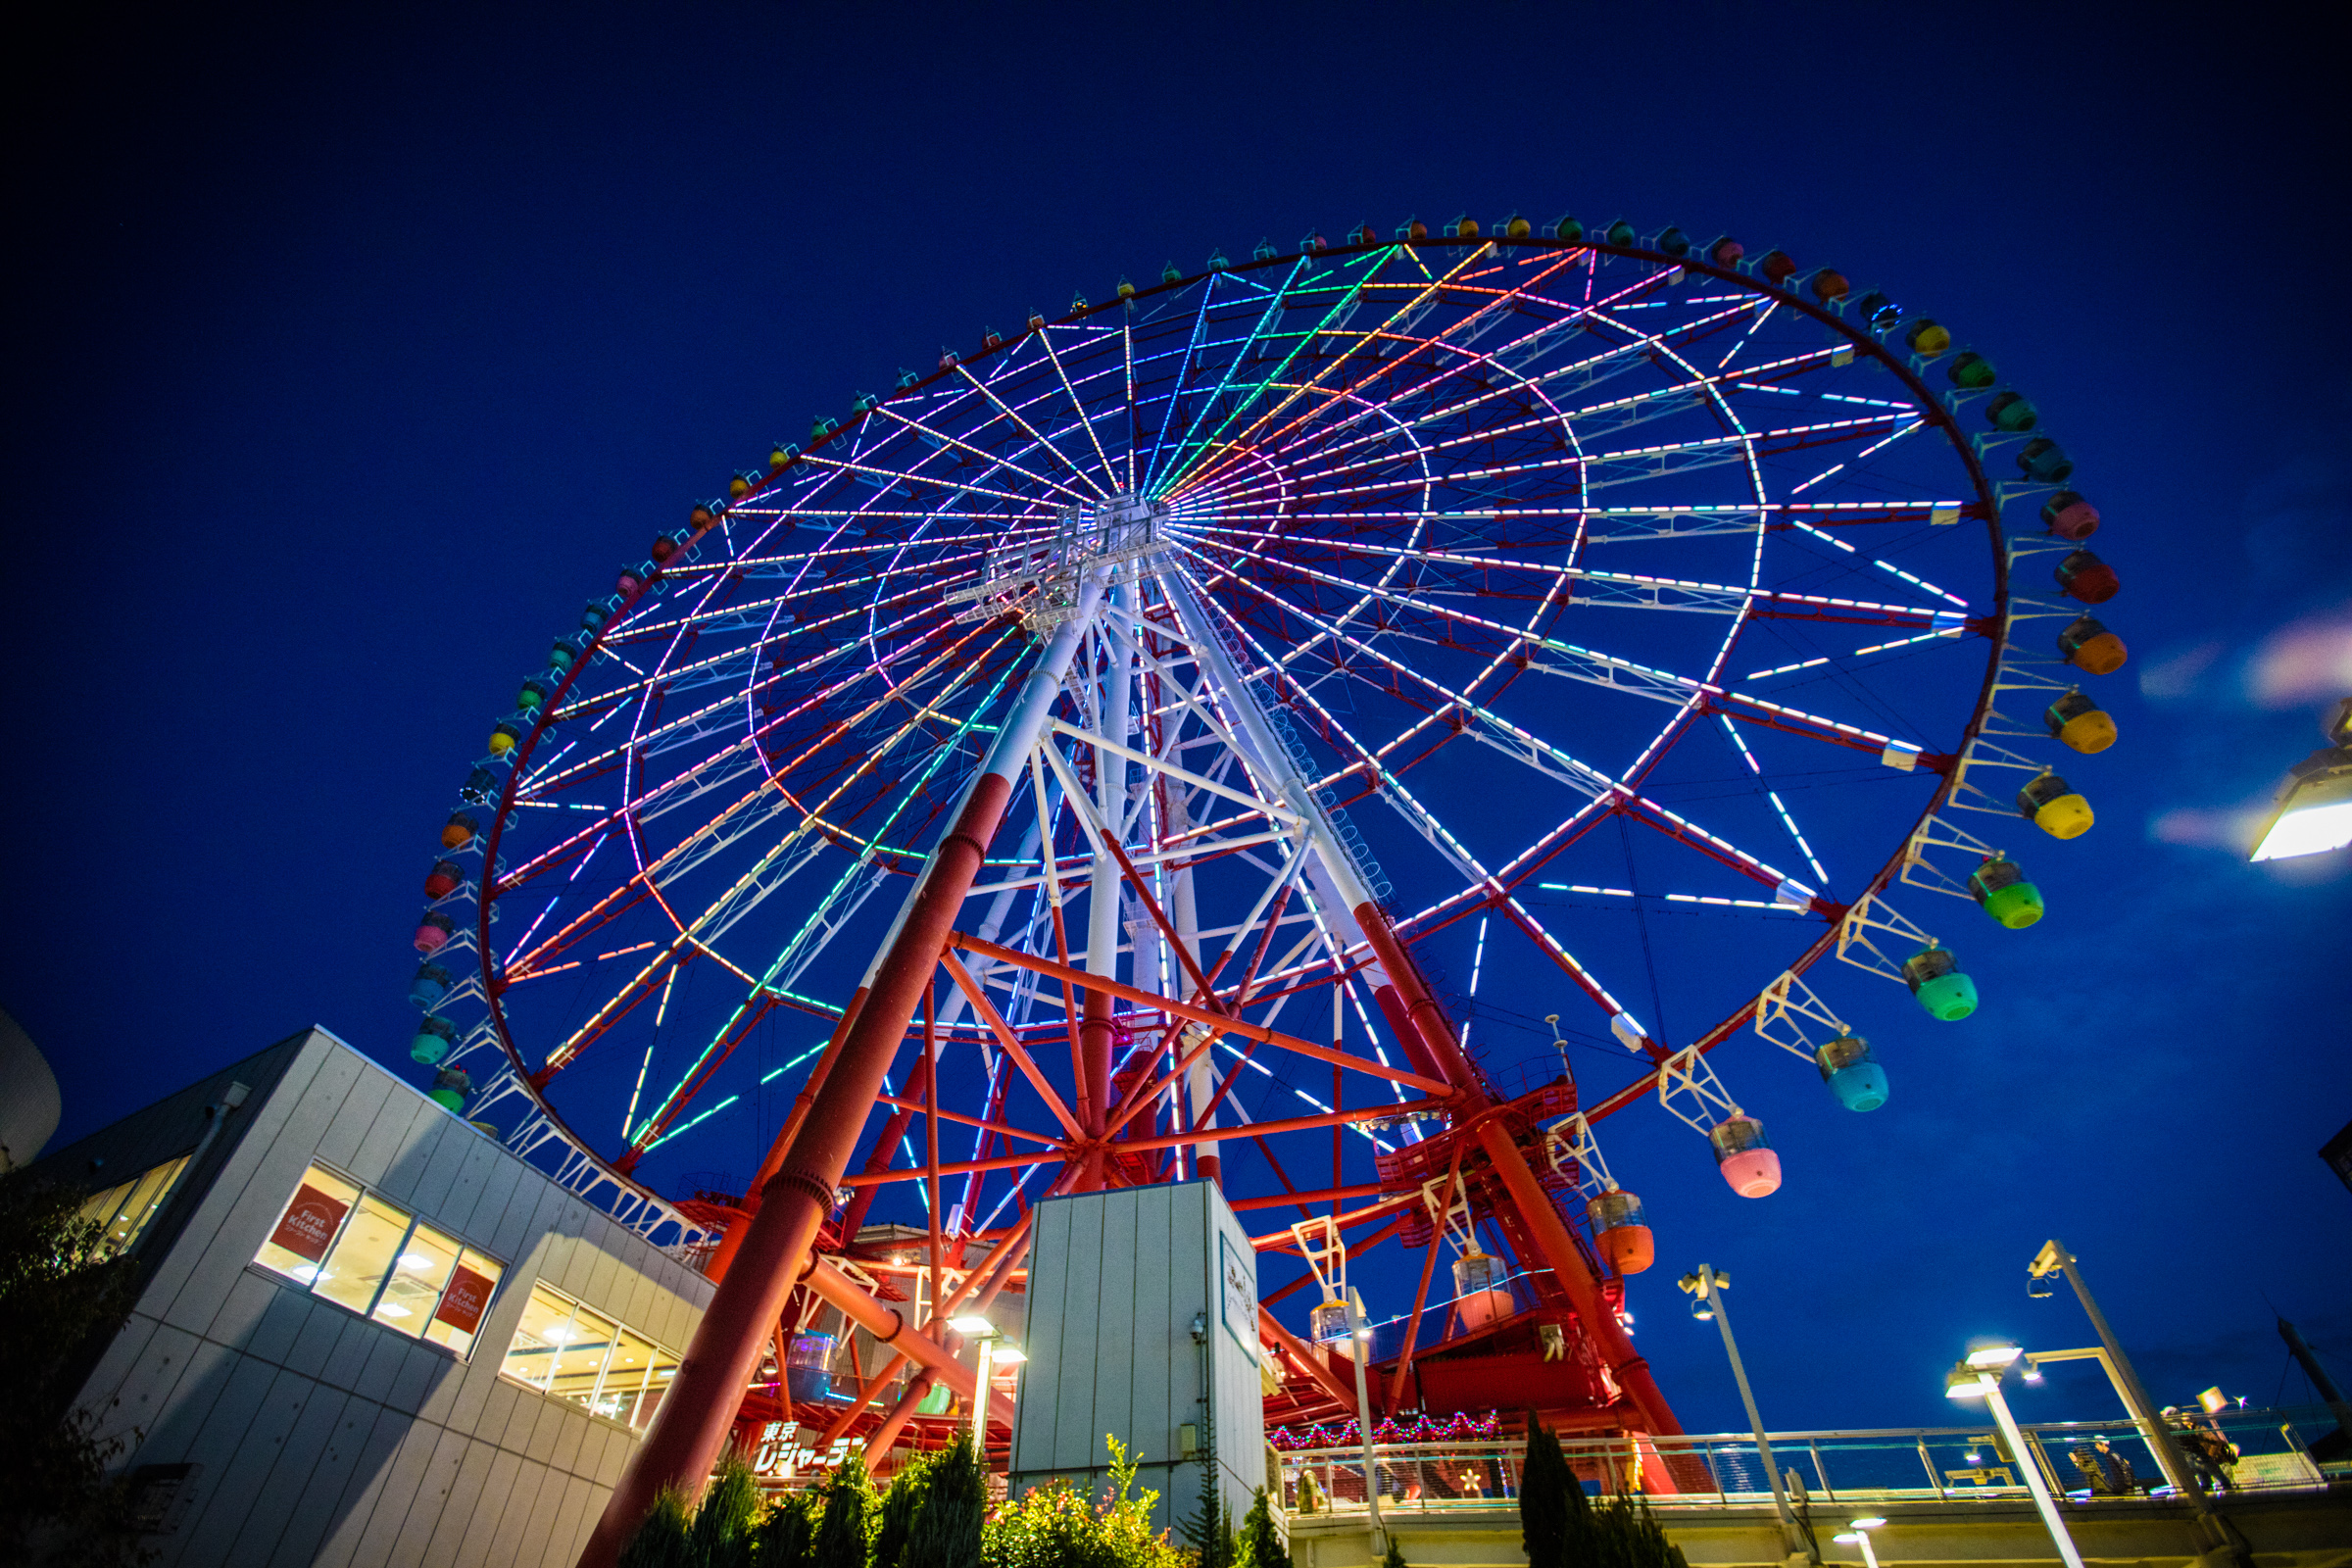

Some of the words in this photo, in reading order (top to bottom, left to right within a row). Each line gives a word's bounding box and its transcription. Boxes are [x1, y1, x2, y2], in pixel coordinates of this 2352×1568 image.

[288, 1214, 328, 1240] Kitchen
[301, 1209, 326, 1228] First
[448, 1293, 479, 1314] Kitchen
[458, 1287, 477, 1303] First
[760, 1420, 800, 1443] 東京
